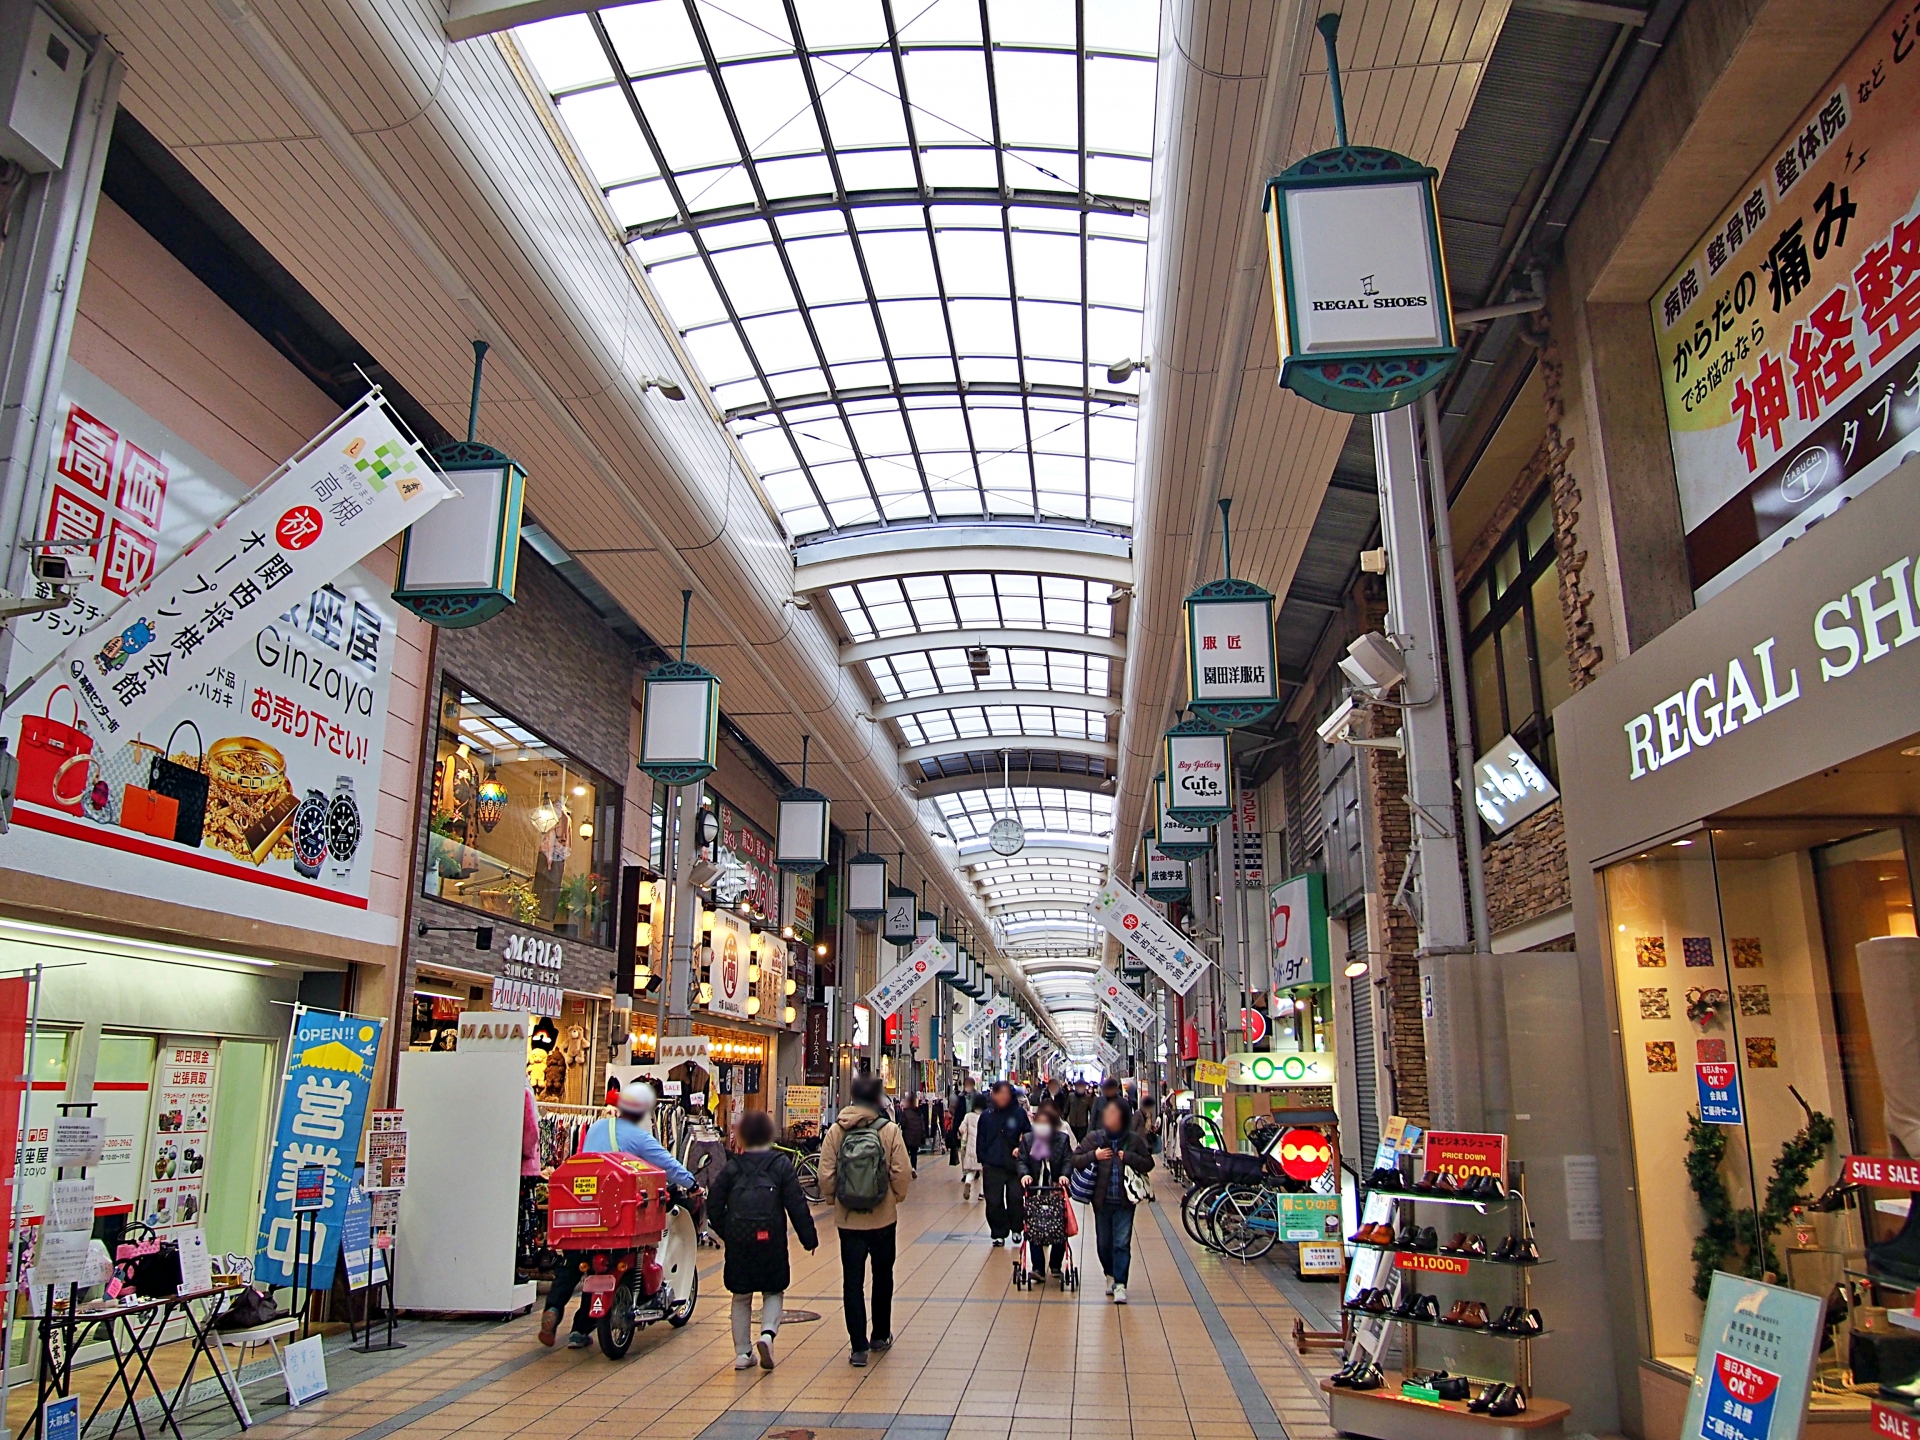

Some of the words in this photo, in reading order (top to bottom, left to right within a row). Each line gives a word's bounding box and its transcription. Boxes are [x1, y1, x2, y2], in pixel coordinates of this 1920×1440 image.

[1663, 268, 1699, 327] 病院
[1706, 187, 1767, 276] 整骨院
[1775, 93, 1846, 197] 整体院
[1857, 59, 1886, 103] など
[1313, 299, 1369, 311] REGAL
[1374, 296, 1428, 309] SHOES
[1681, 318, 1765, 413] でお悩みなら
[1786, 451, 1821, 483] TABUCHI
[339, 464, 375, 506] 将棋のまち
[310, 471, 363, 527] 高槻
[281, 508, 313, 549] 祝
[157, 529, 268, 619] オープン
[112, 553, 293, 707] 関西将棋会館
[256, 624, 374, 717] Ginzaya
[1204, 666, 1265, 685] 園田洋服店
[1624, 636, 1801, 781] REGAL
[251, 686, 369, 765] お売り下さい!
[1193, 760, 1221, 772] Gallery
[1182, 776, 1218, 790] Cute
[1151, 870, 1184, 881] 成徳学苑
[504, 963, 534, 981] SINCE
[539, 971, 560, 985] 1979
[493, 987, 562, 1012] アルパカ100%
[298, 1027, 355, 1042] OPEN!!
[460, 1023, 525, 1040] MAUA
[175, 1050, 209, 1063] 即日現金
[661, 1044, 708, 1058] MAUA
[172, 1071, 208, 1084] 出張買取
[663, 1084, 681, 1092] SALE
[1430, 1137, 1501, 1149] 革ビジネスシューズ
[1441, 1151, 1463, 1160] PRICE
[1464, 1153, 1486, 1161] DOWN
[1852, 1161, 1882, 1182] SALE
[1887, 1164, 1920, 1186] SALE
[1282, 1198, 1338, 1211] 肩こりの店
[1723, 1359, 1764, 1385] 当日入会でも
[1723, 1399, 1754, 1425] 会員様
[1878, 1411, 1912, 1440] SALE
